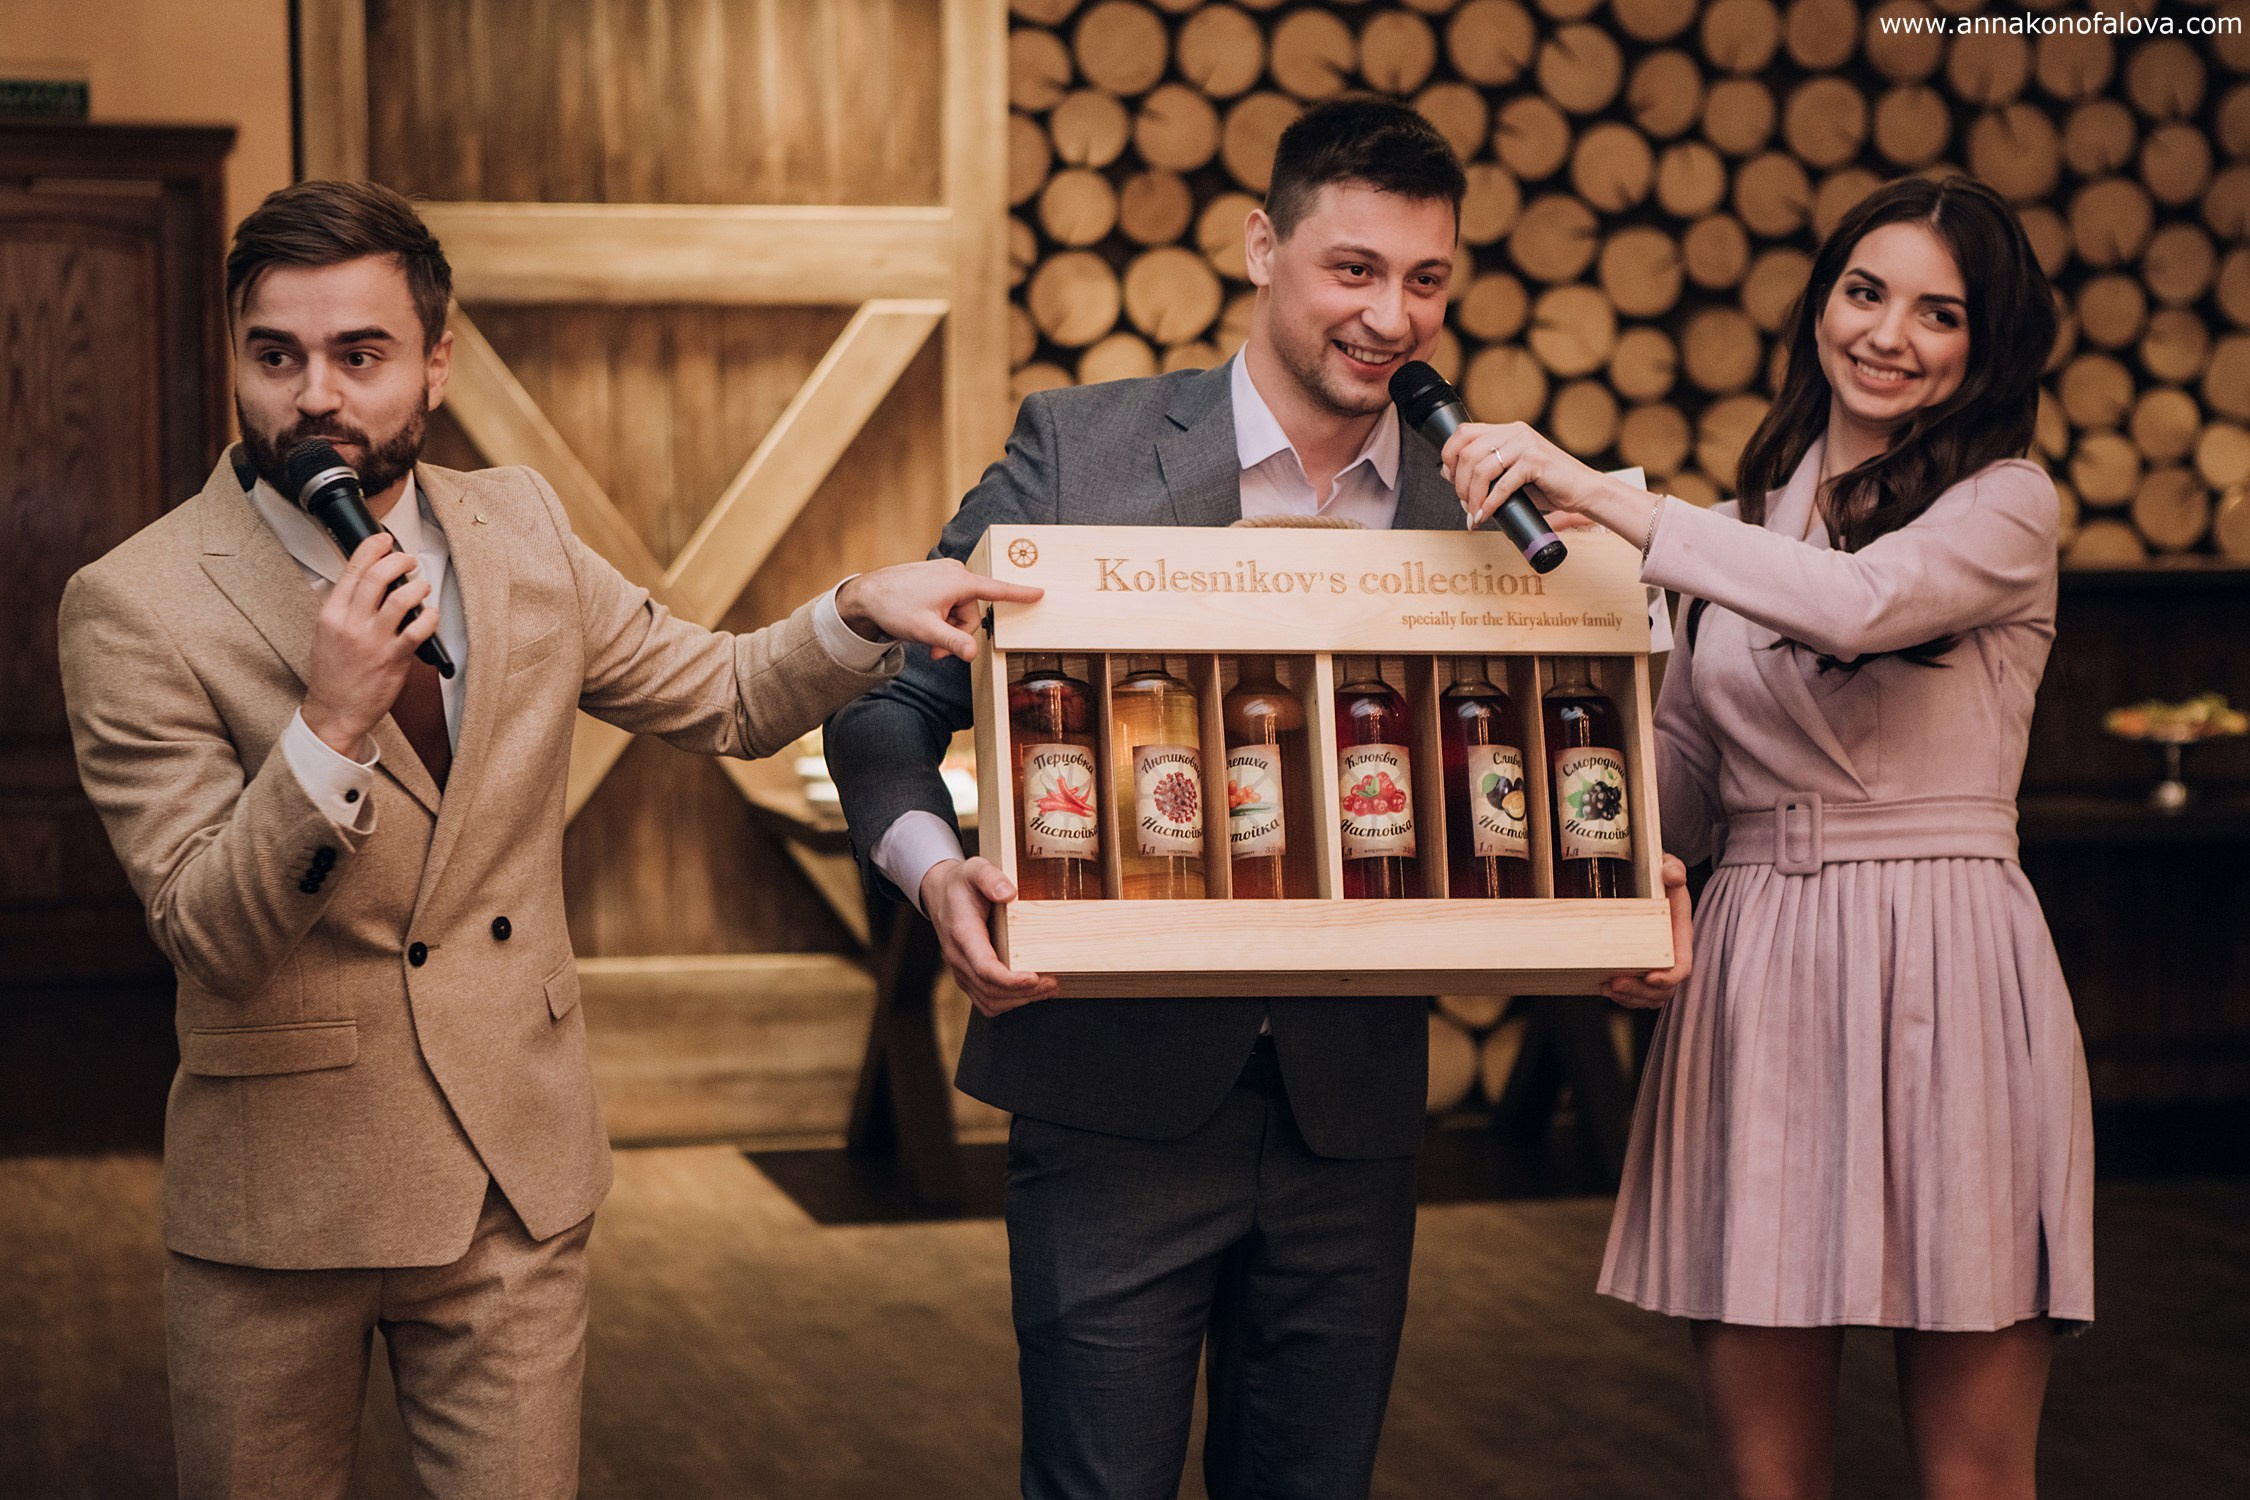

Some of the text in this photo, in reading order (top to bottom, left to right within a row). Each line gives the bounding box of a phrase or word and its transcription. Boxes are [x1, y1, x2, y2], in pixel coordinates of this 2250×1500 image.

[1094, 558, 1547, 597] Kolesnikov's collection
[1401, 610, 1623, 631] specially for the Kiryakulov family
[1033, 752, 1094, 775] Перцовка
[1344, 751, 1399, 770] Клюква
[1141, 815, 1203, 839] Настойк
[1229, 818, 1281, 843] тойка
[1340, 818, 1413, 838] Настойка
